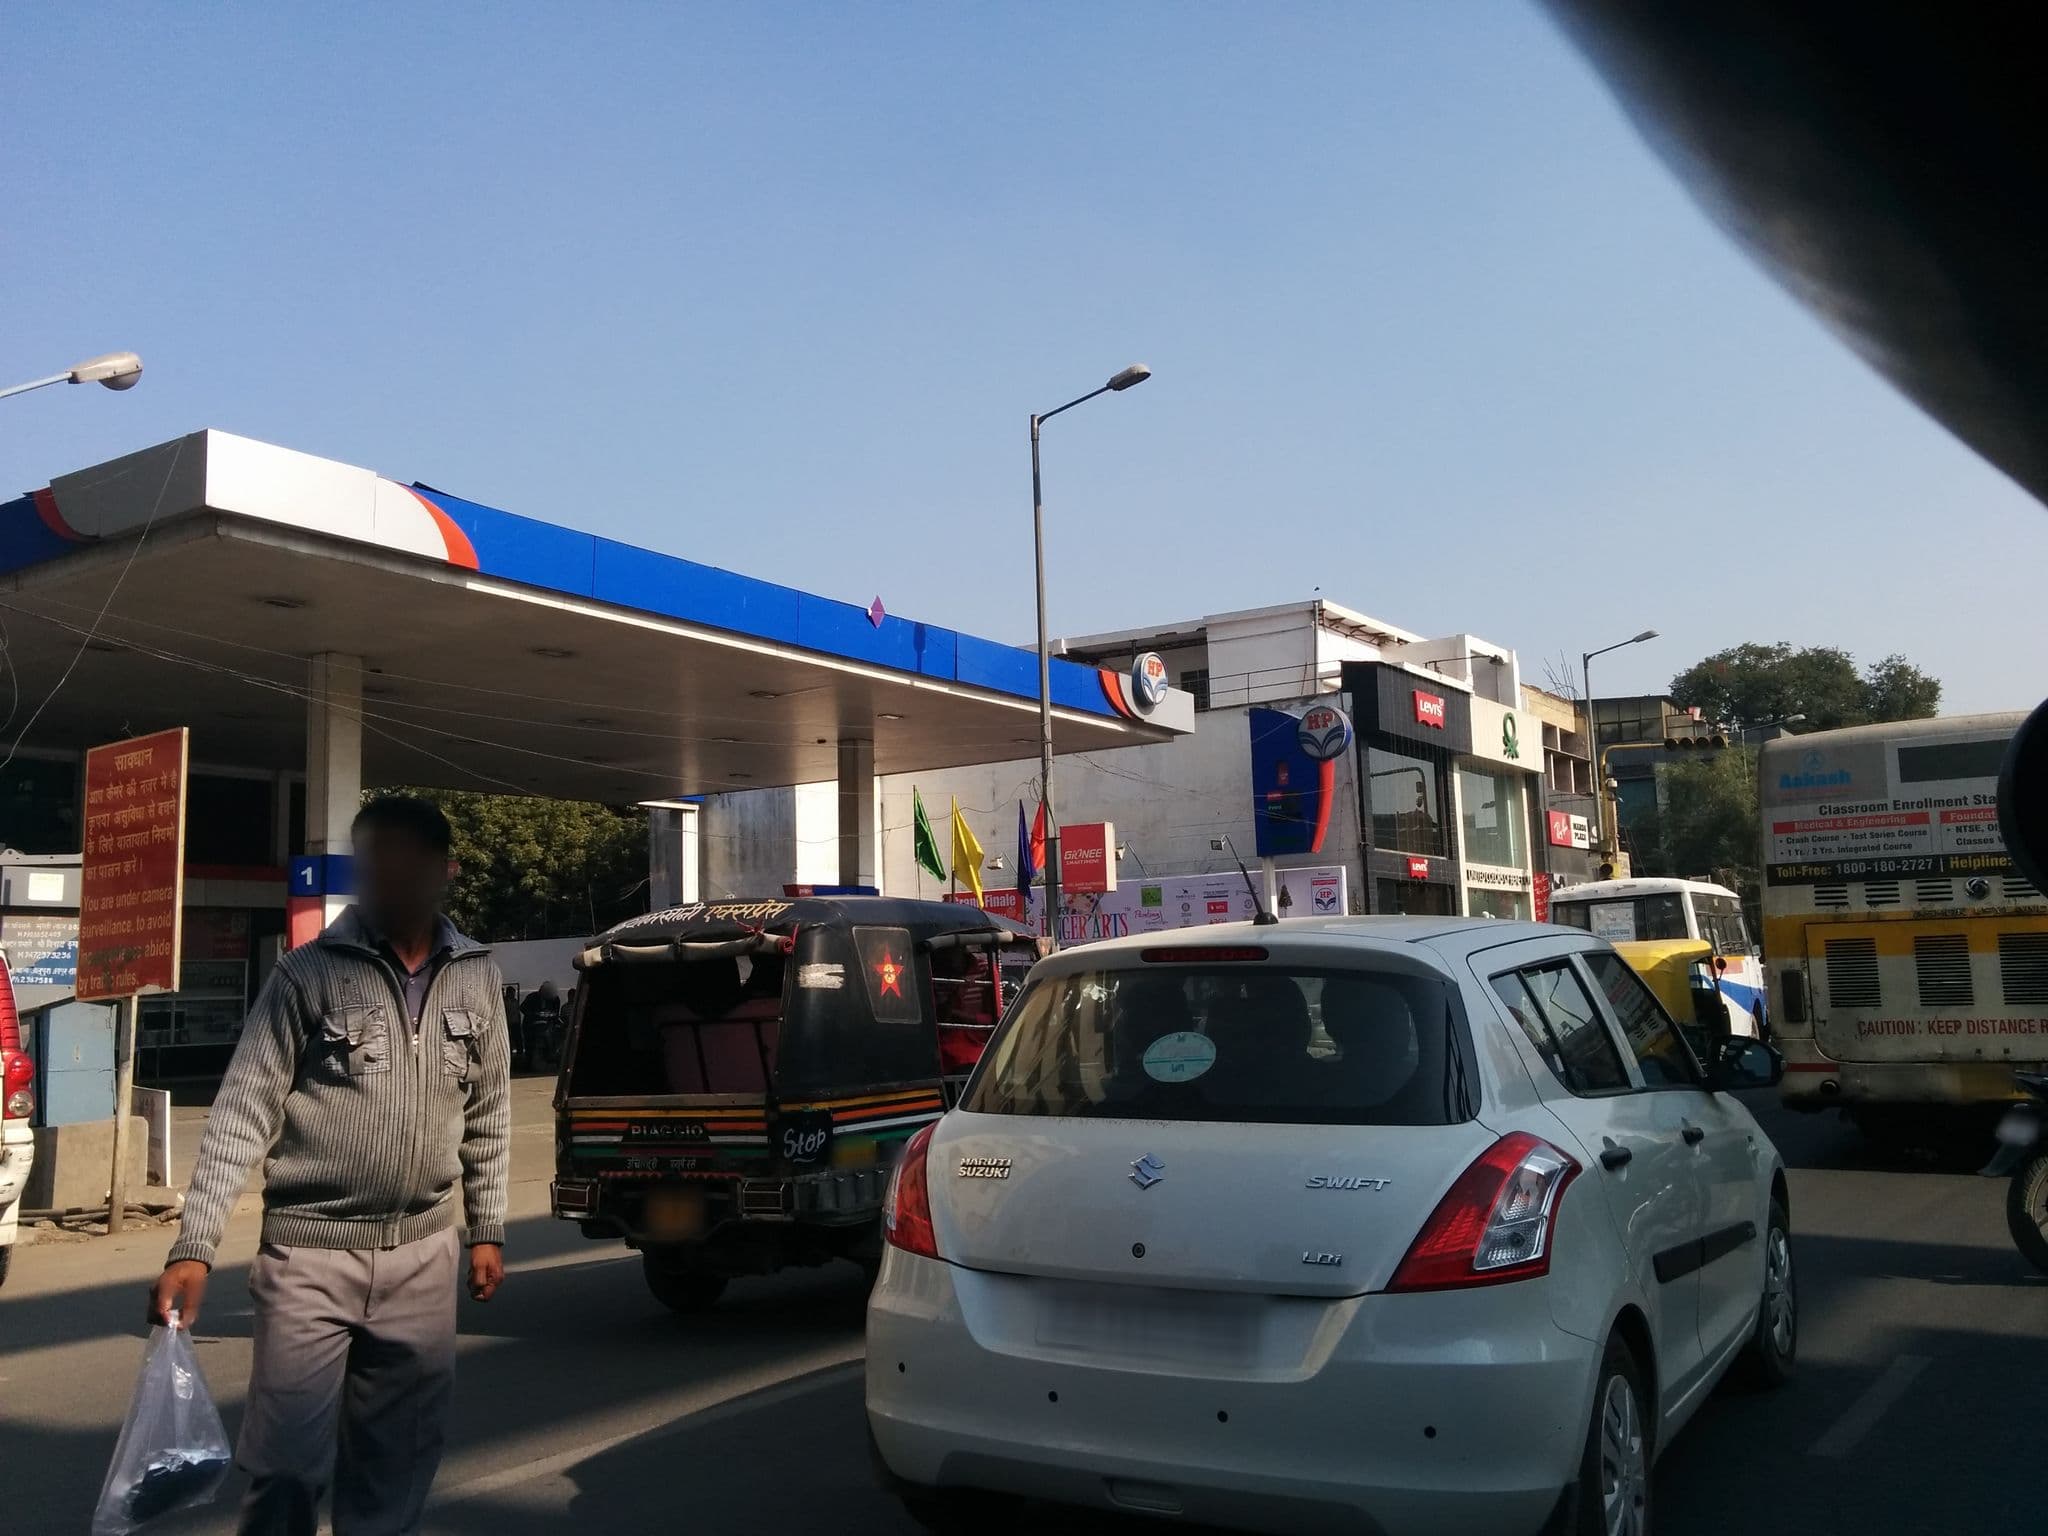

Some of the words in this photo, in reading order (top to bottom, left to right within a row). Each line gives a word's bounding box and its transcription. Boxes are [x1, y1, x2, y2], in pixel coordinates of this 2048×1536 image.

[1307, 712, 1334, 730] HP
[114, 748, 154, 771] सावधान
[1819, 801, 1888, 816] Classroom
[1893, 795, 1969, 812] Enrollment
[1973, 794, 1997, 806] Sta
[1794, 820, 1834, 831] Medical
[1847, 815, 1907, 828] Engineering
[1950, 811, 1996, 821] Foundat
[1786, 836, 1809, 845] Crash
[1812, 834, 1840, 843] Course
[1850, 832, 1868, 841] Test
[1870, 830, 1895, 839] Series
[1898, 829, 1928, 838] Course
[1956, 837, 1994, 846] Classes
[1837, 843, 1881, 854] Integrated
[1883, 841, 1913, 851] Course
[301, 866, 313, 886] 1
[1776, 865, 1832, 878] Toll-Free:
[1836, 858, 1933, 875] 1800-180-2727
[1949, 857, 2012, 871] Helpline:
[83, 896, 99, 912] You
[101, 896, 114, 910] are
[116, 888, 141, 908] under
[143, 887, 173, 903] camera
[985, 893, 1016, 908] Finale
[136, 914, 146, 932] to
[147, 910, 172, 931] avoid
[1093, 912, 1128, 940] ARTS
[144, 938, 171, 958] abide
[79, 975, 89, 995] by
[116, 969, 139, 987] rules.
[1927, 1018, 1963, 1035] KEEP
[1966, 1019, 2036, 1035] DISTANCE
[960, 1158, 1012, 1167] MARUTI
[958, 1166, 1010, 1178] SUZUKI
[1305, 1176, 1392, 1191] SWIFT
